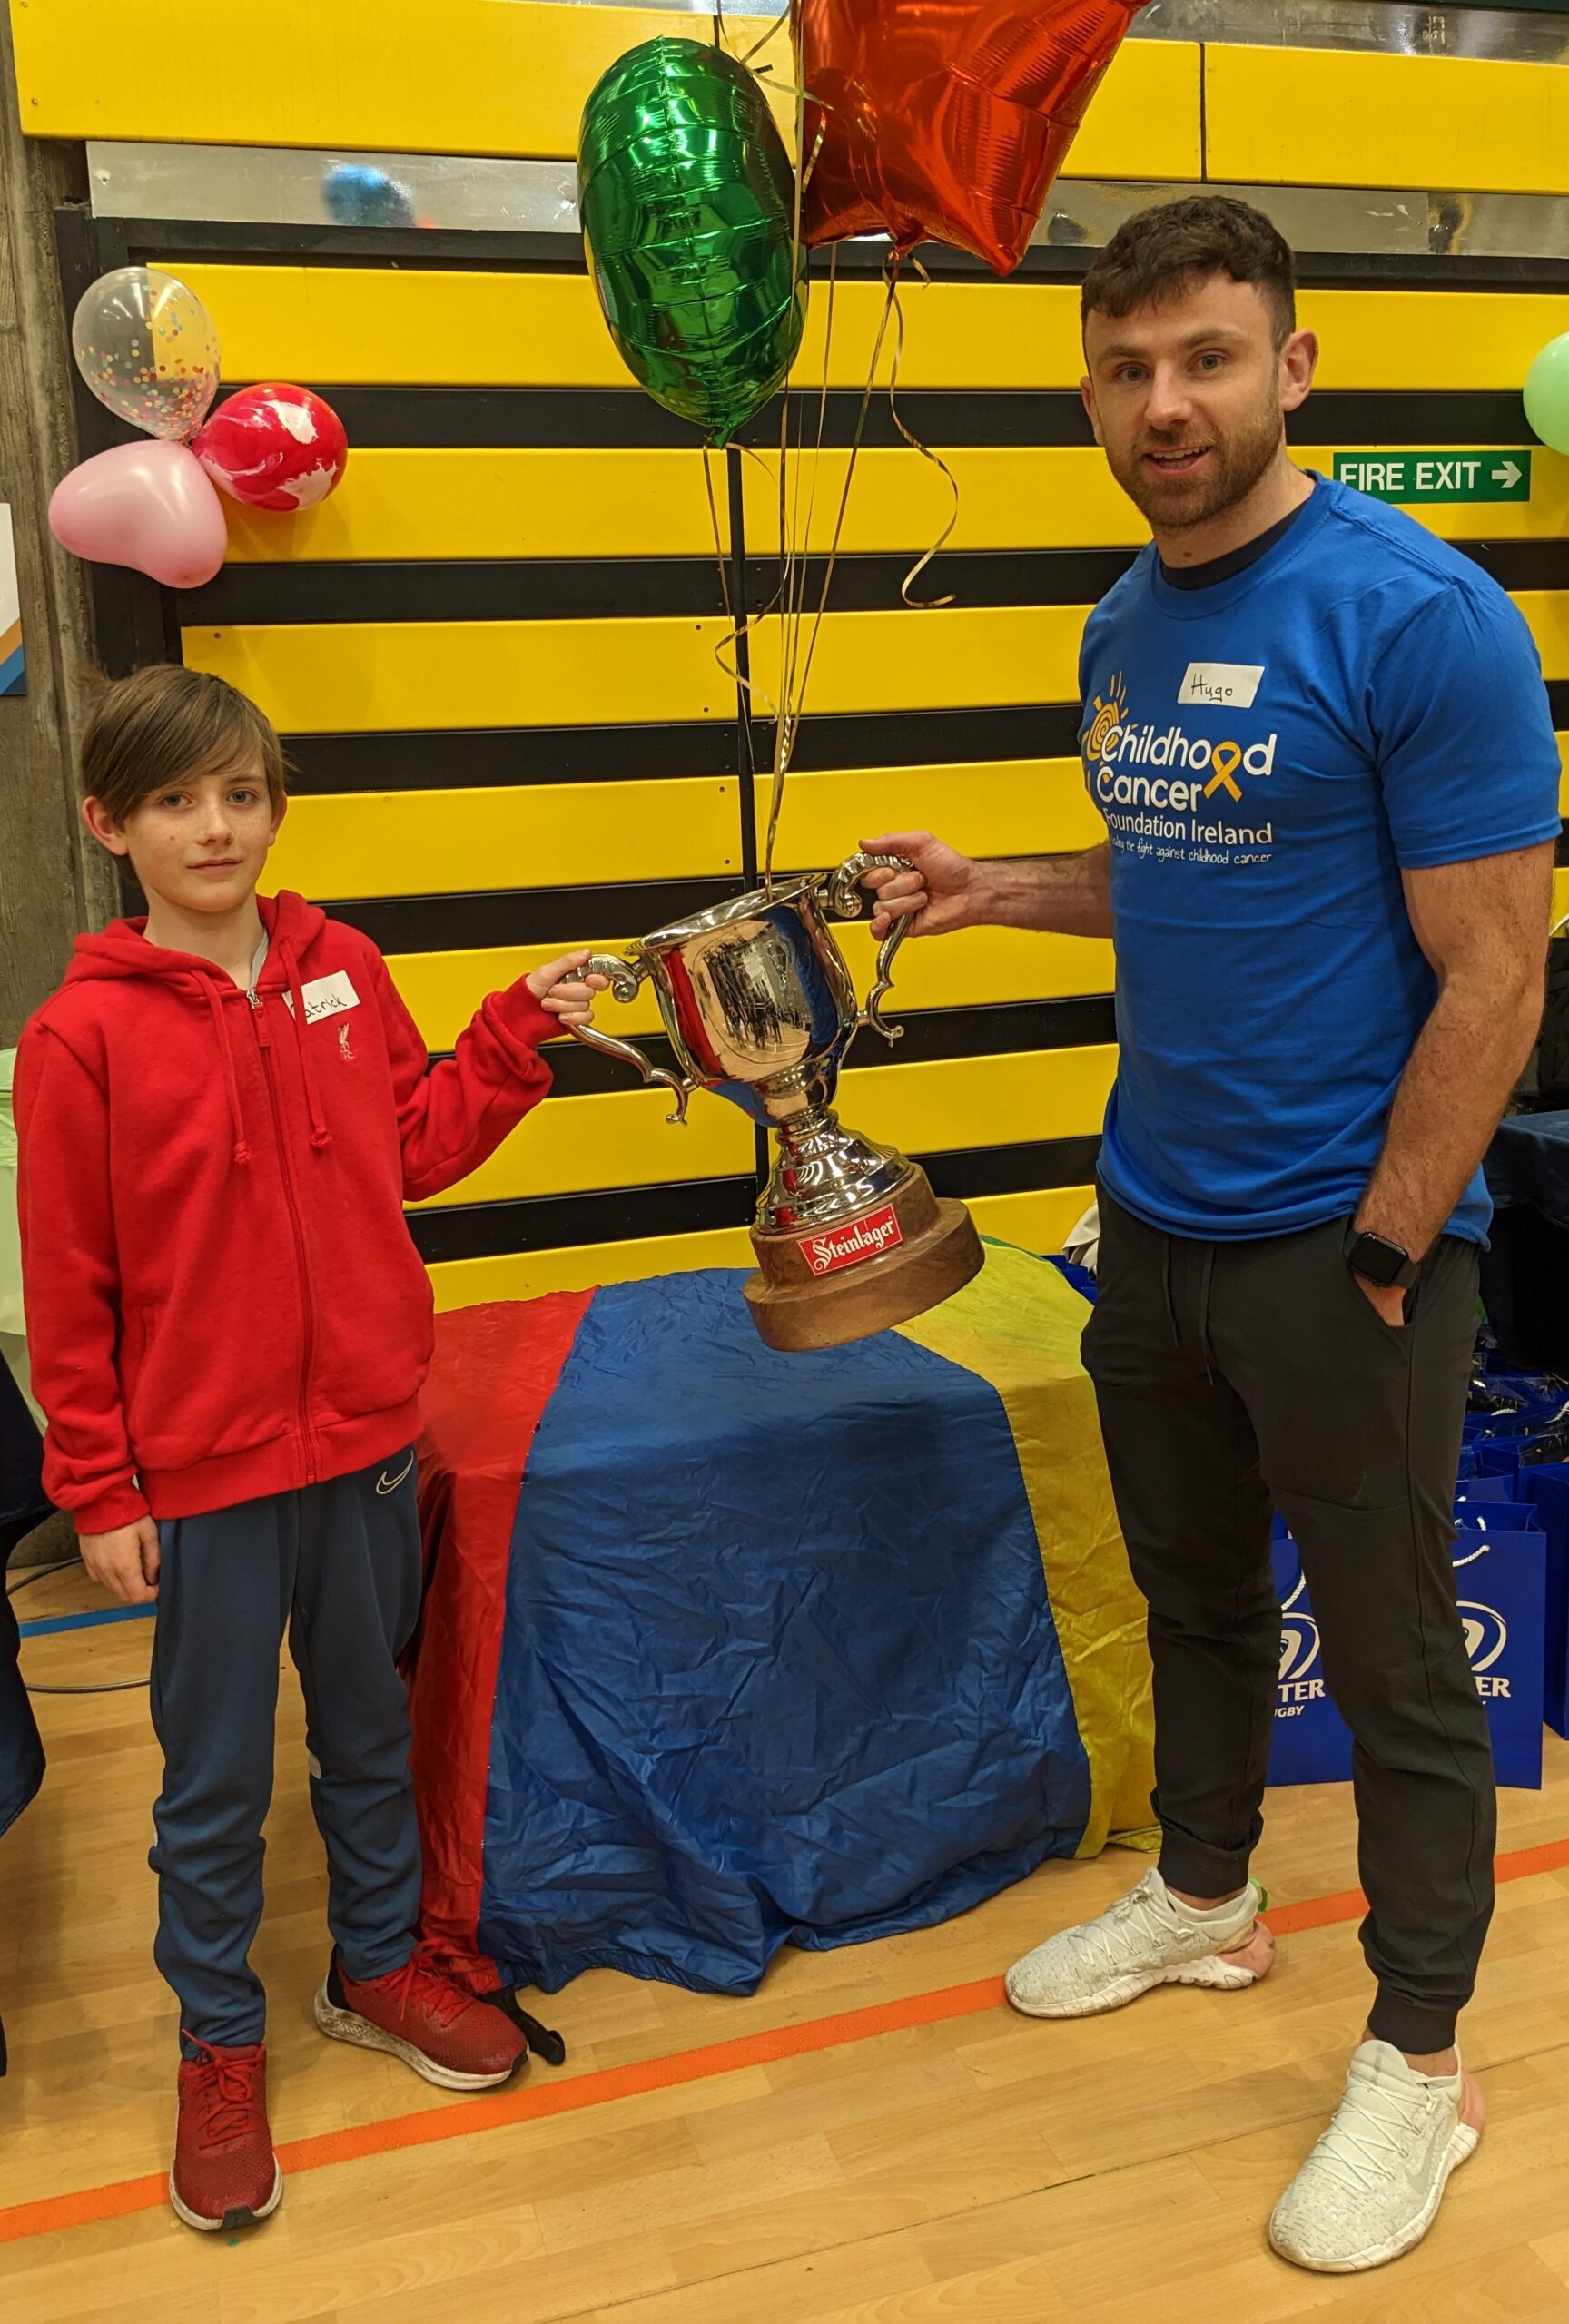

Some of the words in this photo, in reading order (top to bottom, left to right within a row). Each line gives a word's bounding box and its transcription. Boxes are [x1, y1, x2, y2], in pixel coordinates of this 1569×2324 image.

[1340, 462, 1405, 491] FIRE
[1416, 461, 1482, 490] EXIT
[1190, 673, 1234, 703] Hugo
[1096, 765, 1203, 812] Cancer
[1102, 807, 1186, 841] Foundation
[1191, 818, 1273, 845] Ireland
[1137, 836, 1153, 860] fight
[1156, 845, 1186, 862] against
[1189, 847, 1229, 864] childhood
[1233, 853, 1273, 865] cancer
[290, 993, 348, 1019] atrick
[812, 1219, 894, 1271] Steinlager
[1274, 1705, 1305, 1718] GBY
